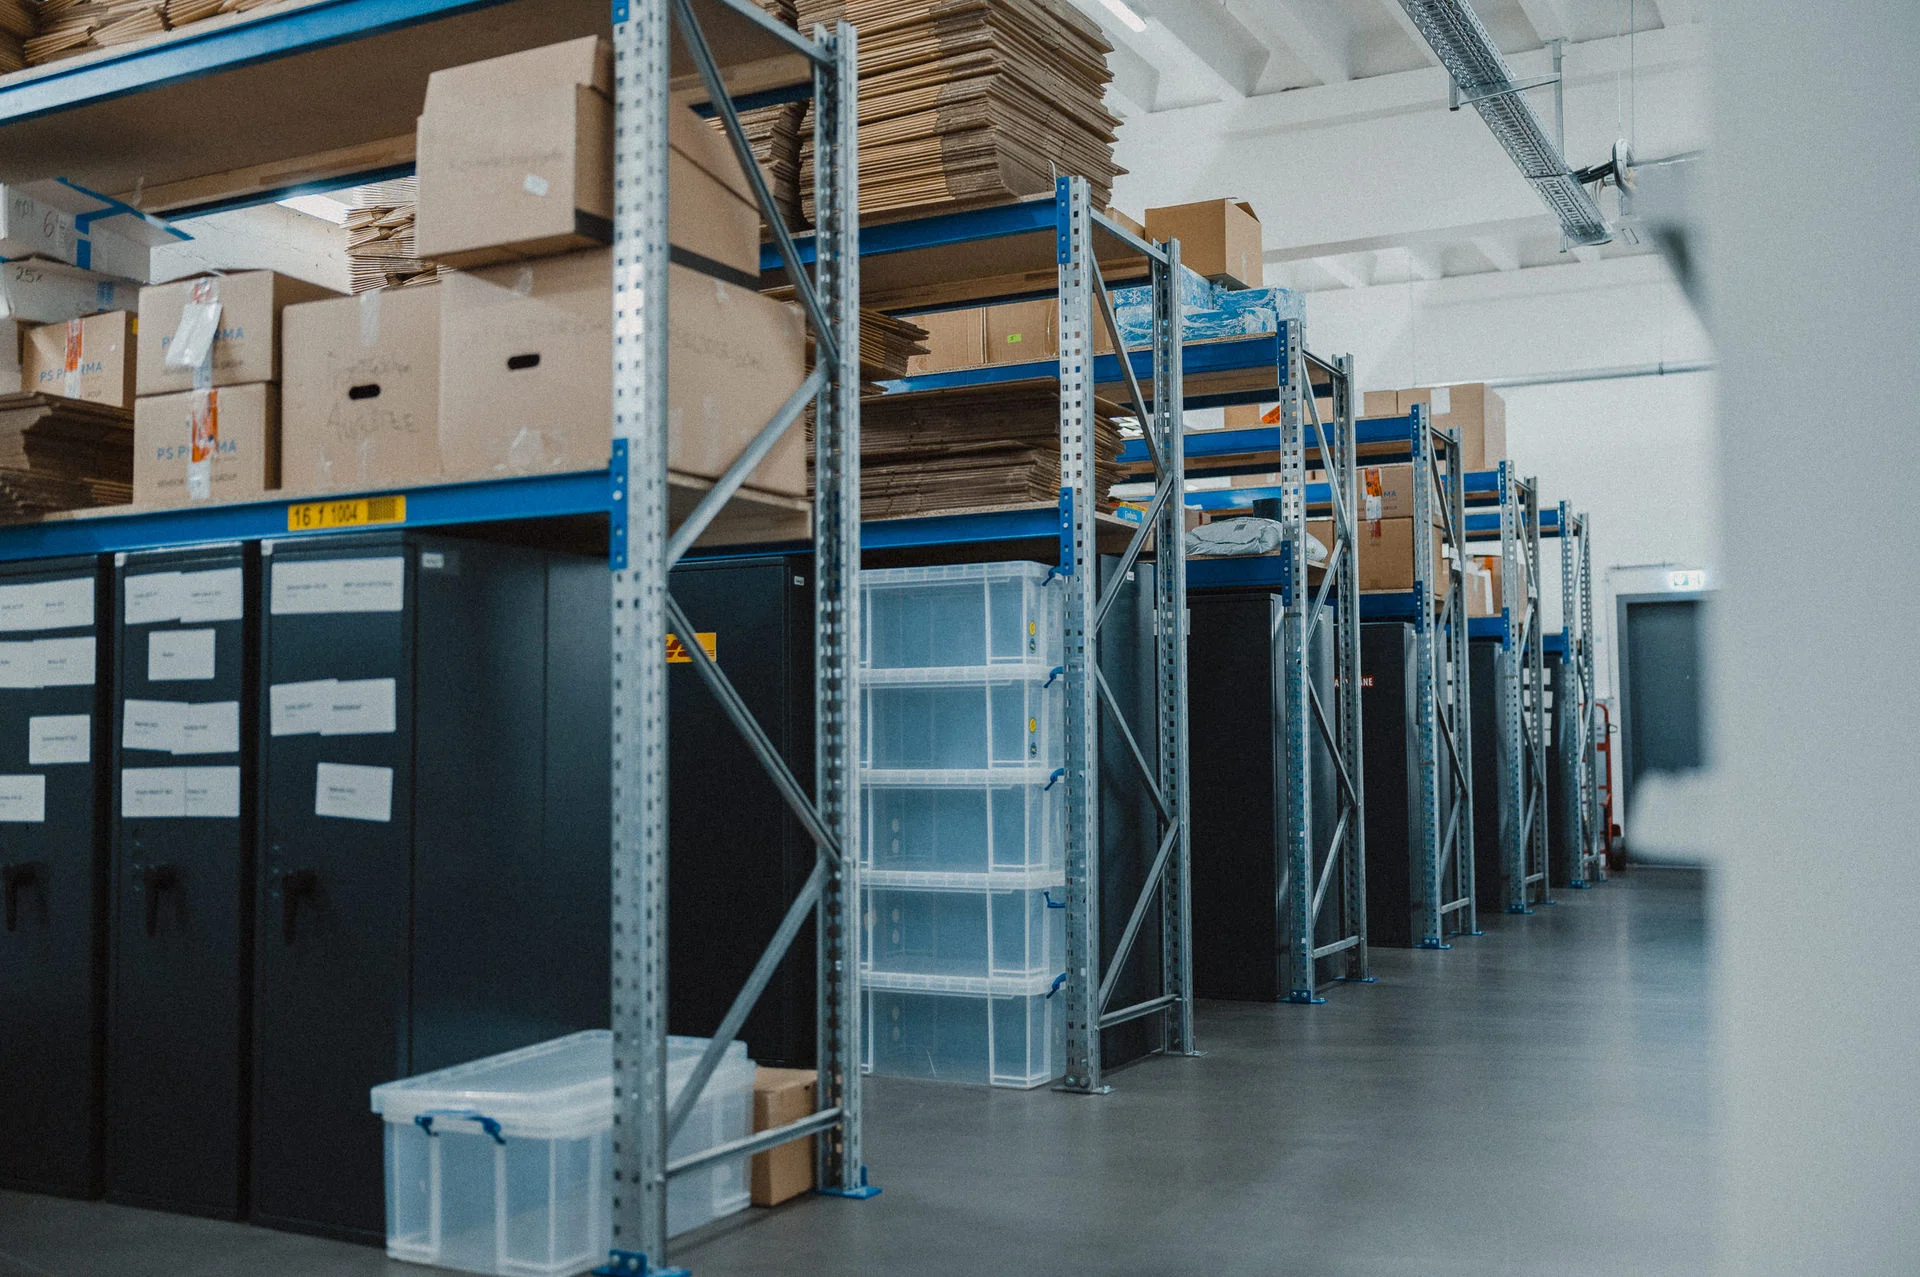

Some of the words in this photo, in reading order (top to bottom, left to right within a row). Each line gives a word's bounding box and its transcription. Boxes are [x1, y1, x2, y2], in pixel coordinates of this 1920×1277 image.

[40, 369, 54, 384] PS
[156, 447, 174, 461] PS
[294, 507, 311, 527] 16
